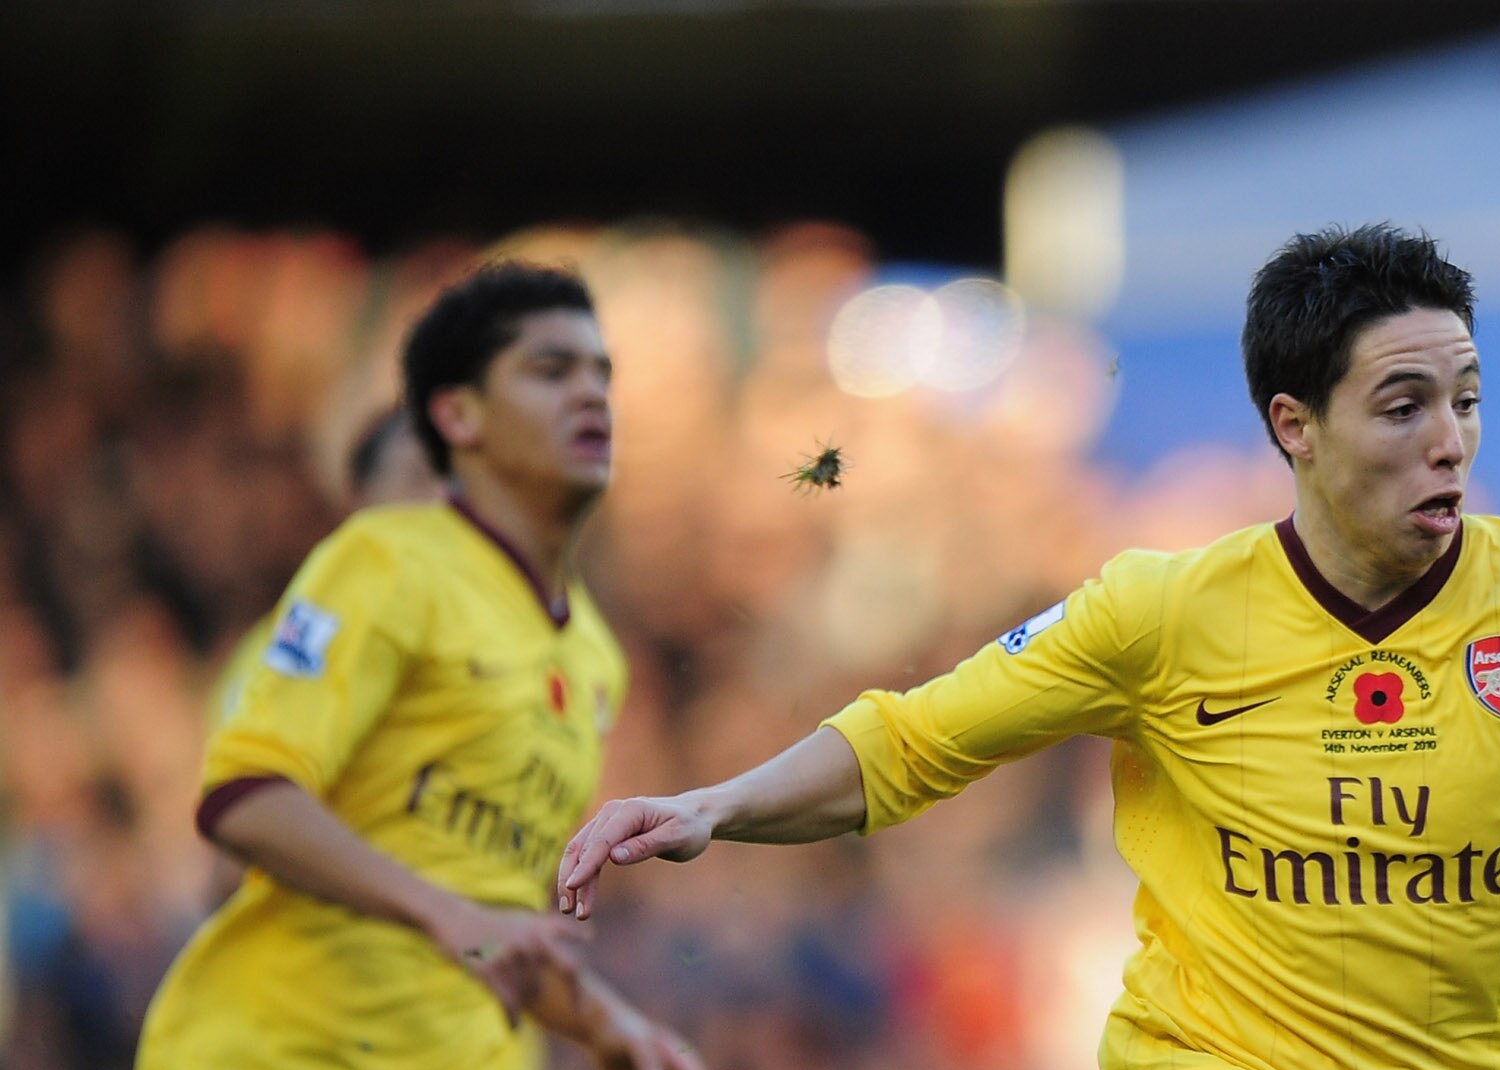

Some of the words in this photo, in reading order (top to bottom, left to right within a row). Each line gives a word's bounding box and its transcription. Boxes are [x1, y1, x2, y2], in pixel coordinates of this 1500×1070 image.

[1325, 655, 1365, 704] ARSENAL
[1371, 651, 1432, 700] REMEMBERS
[1321, 729, 1371, 740] EVERTON
[1389, 727, 1437, 738] ARSENAL
[1323, 742, 1346, 753] 14th
[1350, 742, 1408, 753] November
[1412, 740, 1438, 751] 2010
[1327, 777, 1431, 836] Fly
